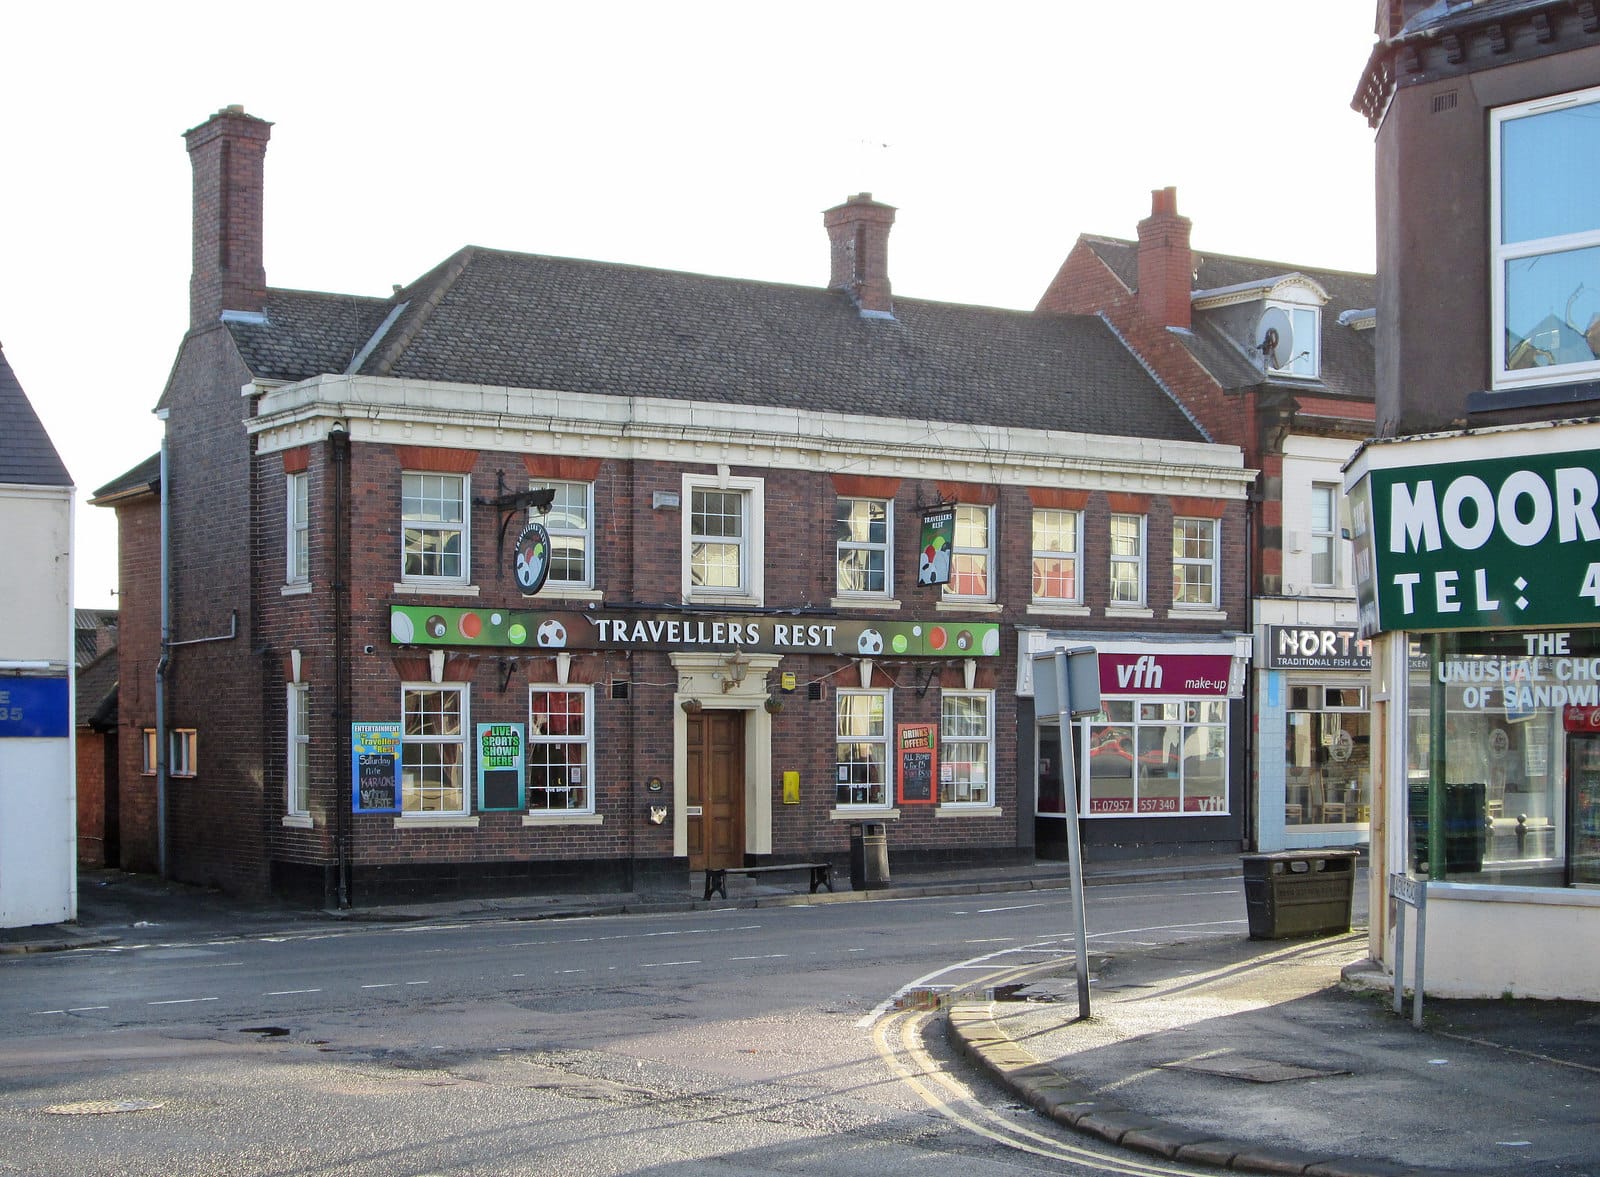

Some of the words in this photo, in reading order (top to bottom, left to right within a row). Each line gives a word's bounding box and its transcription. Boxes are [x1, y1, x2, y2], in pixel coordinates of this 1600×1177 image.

[1390, 467, 1600, 554] MOOR
[924, 513, 953, 524] TRAVELLERS
[1393, 568, 1529, 615] TEL:
[595, 619, 760, 645] TRAVELLERS
[774, 624, 837, 647] REST
[1523, 633, 1570, 655] THE
[1277, 657, 1331, 666] TRADITIONAL
[1333, 658, 1350, 666] FISH
[1116, 656, 1163, 689] vfh
[1438, 658, 1546, 683] UNUSUAL
[1185, 677, 1227, 692] make-up
[1463, 687, 1494, 708] OF
[491, 726, 511, 736] LIVE
[903, 728, 928, 739] DRINKS
[361, 737, 400, 746] Travellers
[483, 736, 519, 747] SPORTS
[904, 737, 928, 748] OFFERS
[483, 746, 519, 756] SHOWN
[360, 755, 390, 766] Saturday
[490, 756, 514, 766] HERE
[1102, 801, 1130, 811] 07957
[1141, 800, 1158, 810] 557
[1159, 800, 1175, 810] 340
